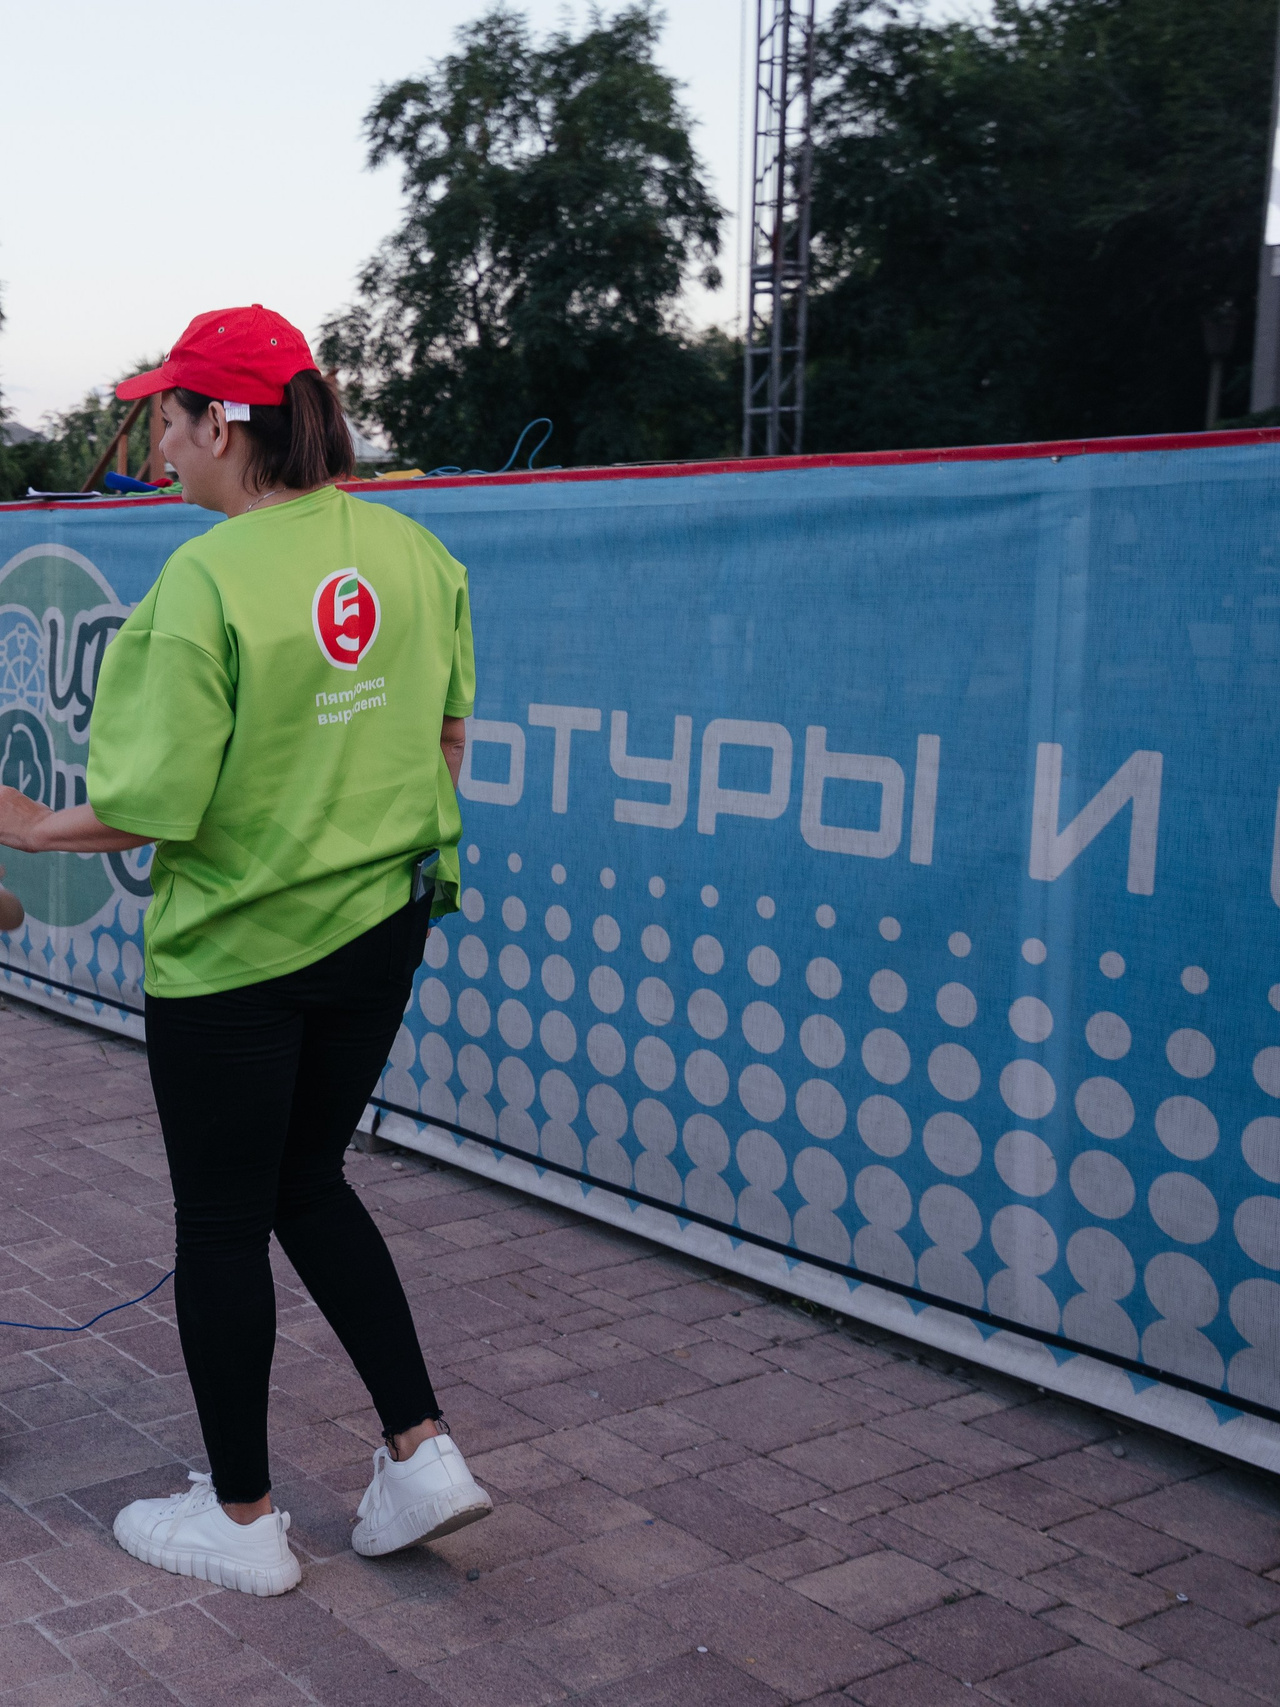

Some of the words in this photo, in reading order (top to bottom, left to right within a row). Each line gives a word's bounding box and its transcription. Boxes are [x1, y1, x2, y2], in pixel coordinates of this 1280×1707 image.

[315, 676, 385, 707] Пяточка
[317, 692, 388, 725] вырает!
[458, 703, 940, 866] ЬТУРЫ
[1029, 742, 1163, 896] И
